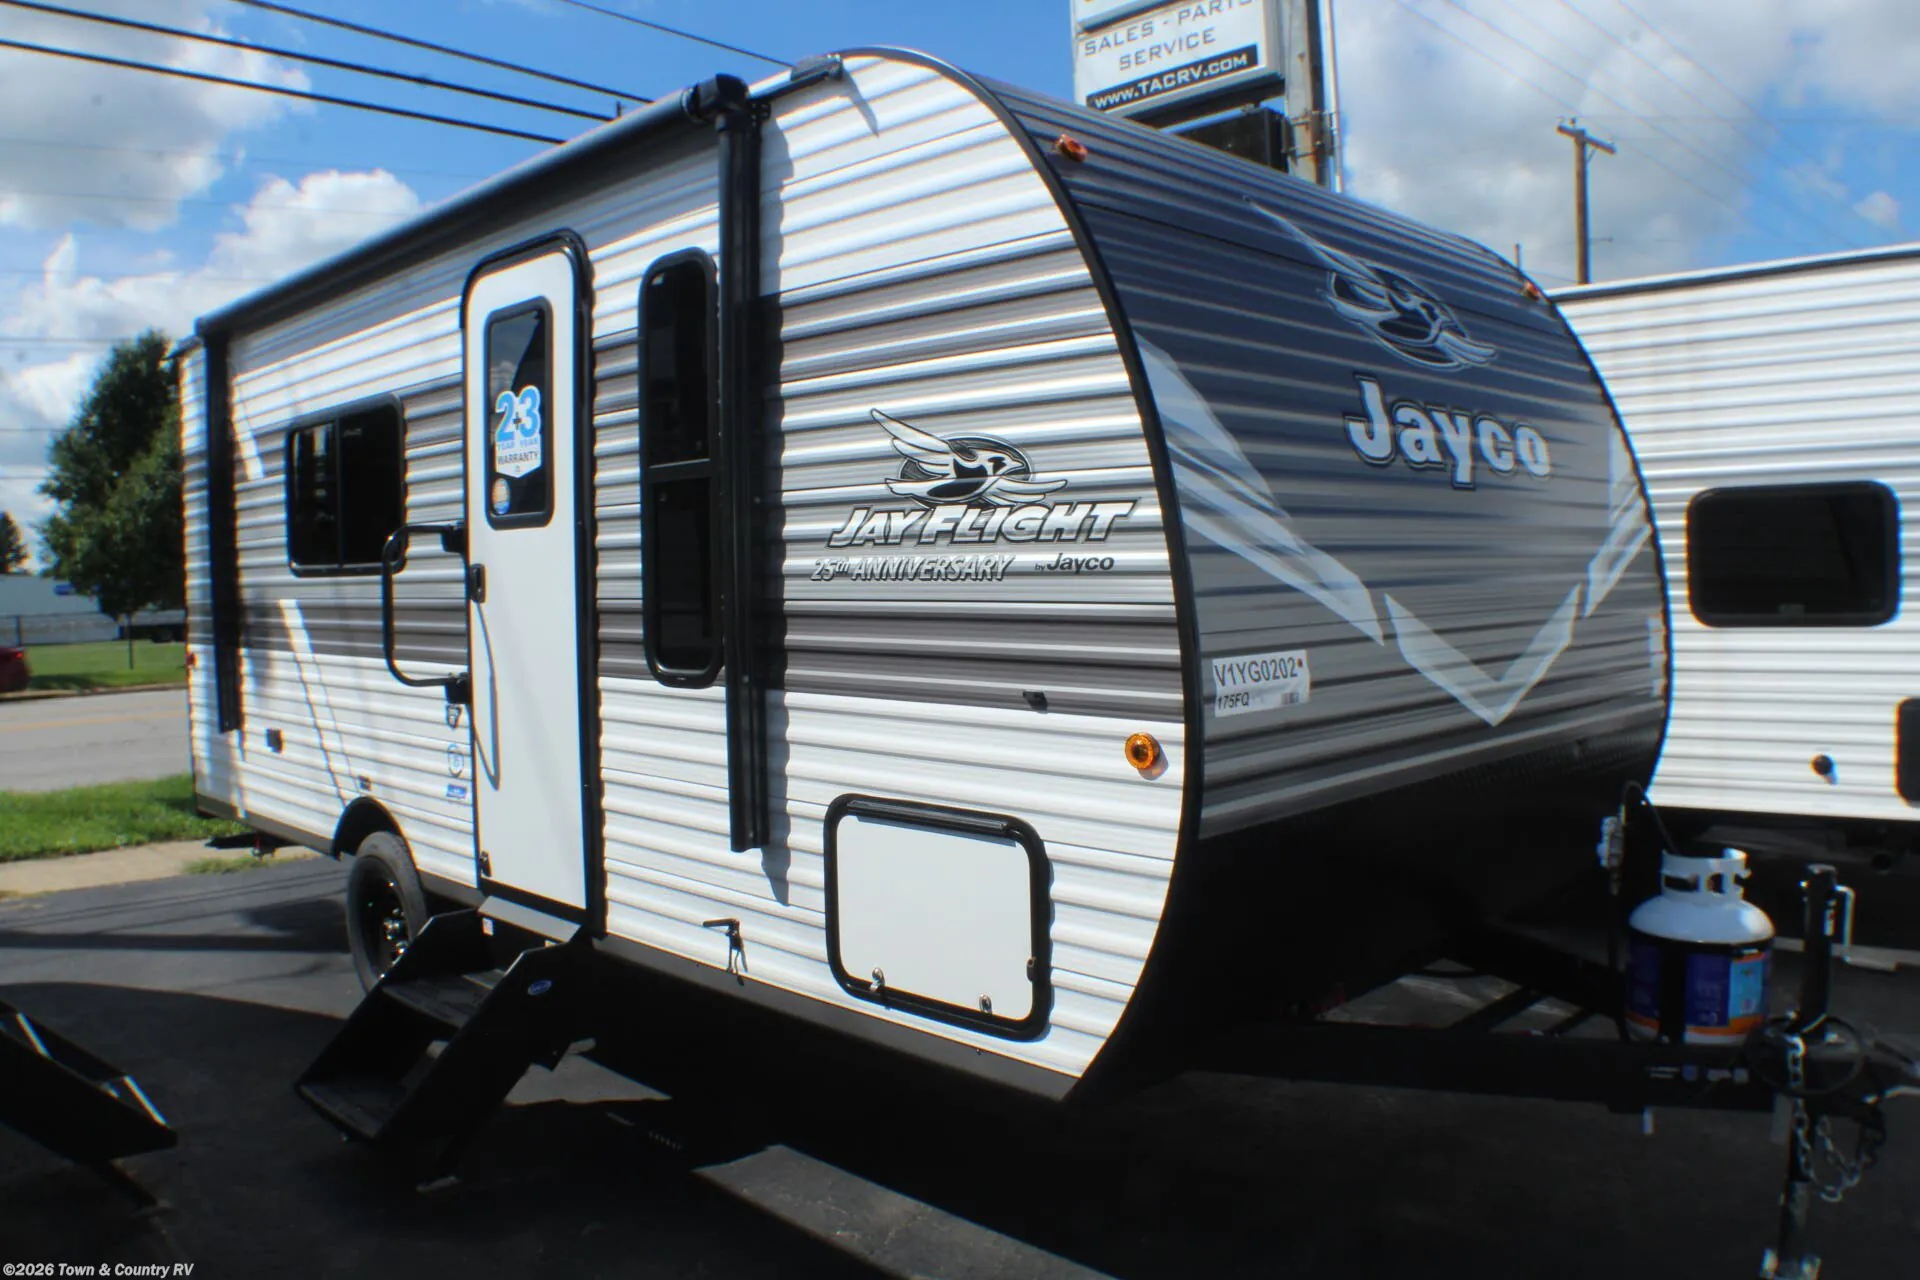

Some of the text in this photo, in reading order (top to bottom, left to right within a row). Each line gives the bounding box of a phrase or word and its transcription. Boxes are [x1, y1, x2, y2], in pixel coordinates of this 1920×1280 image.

[1084, 22, 1155, 56] SALES
[1119, 27, 1216, 71] SERVICE
[1343, 372, 1551, 490] Jayco
[498, 451, 539, 464] WARRANTY
[811, 554, 1015, 582] 25th ANNIVERSARY
[1046, 553, 1115, 574] Jayco
[1214, 657, 1298, 687] V1YG0202
